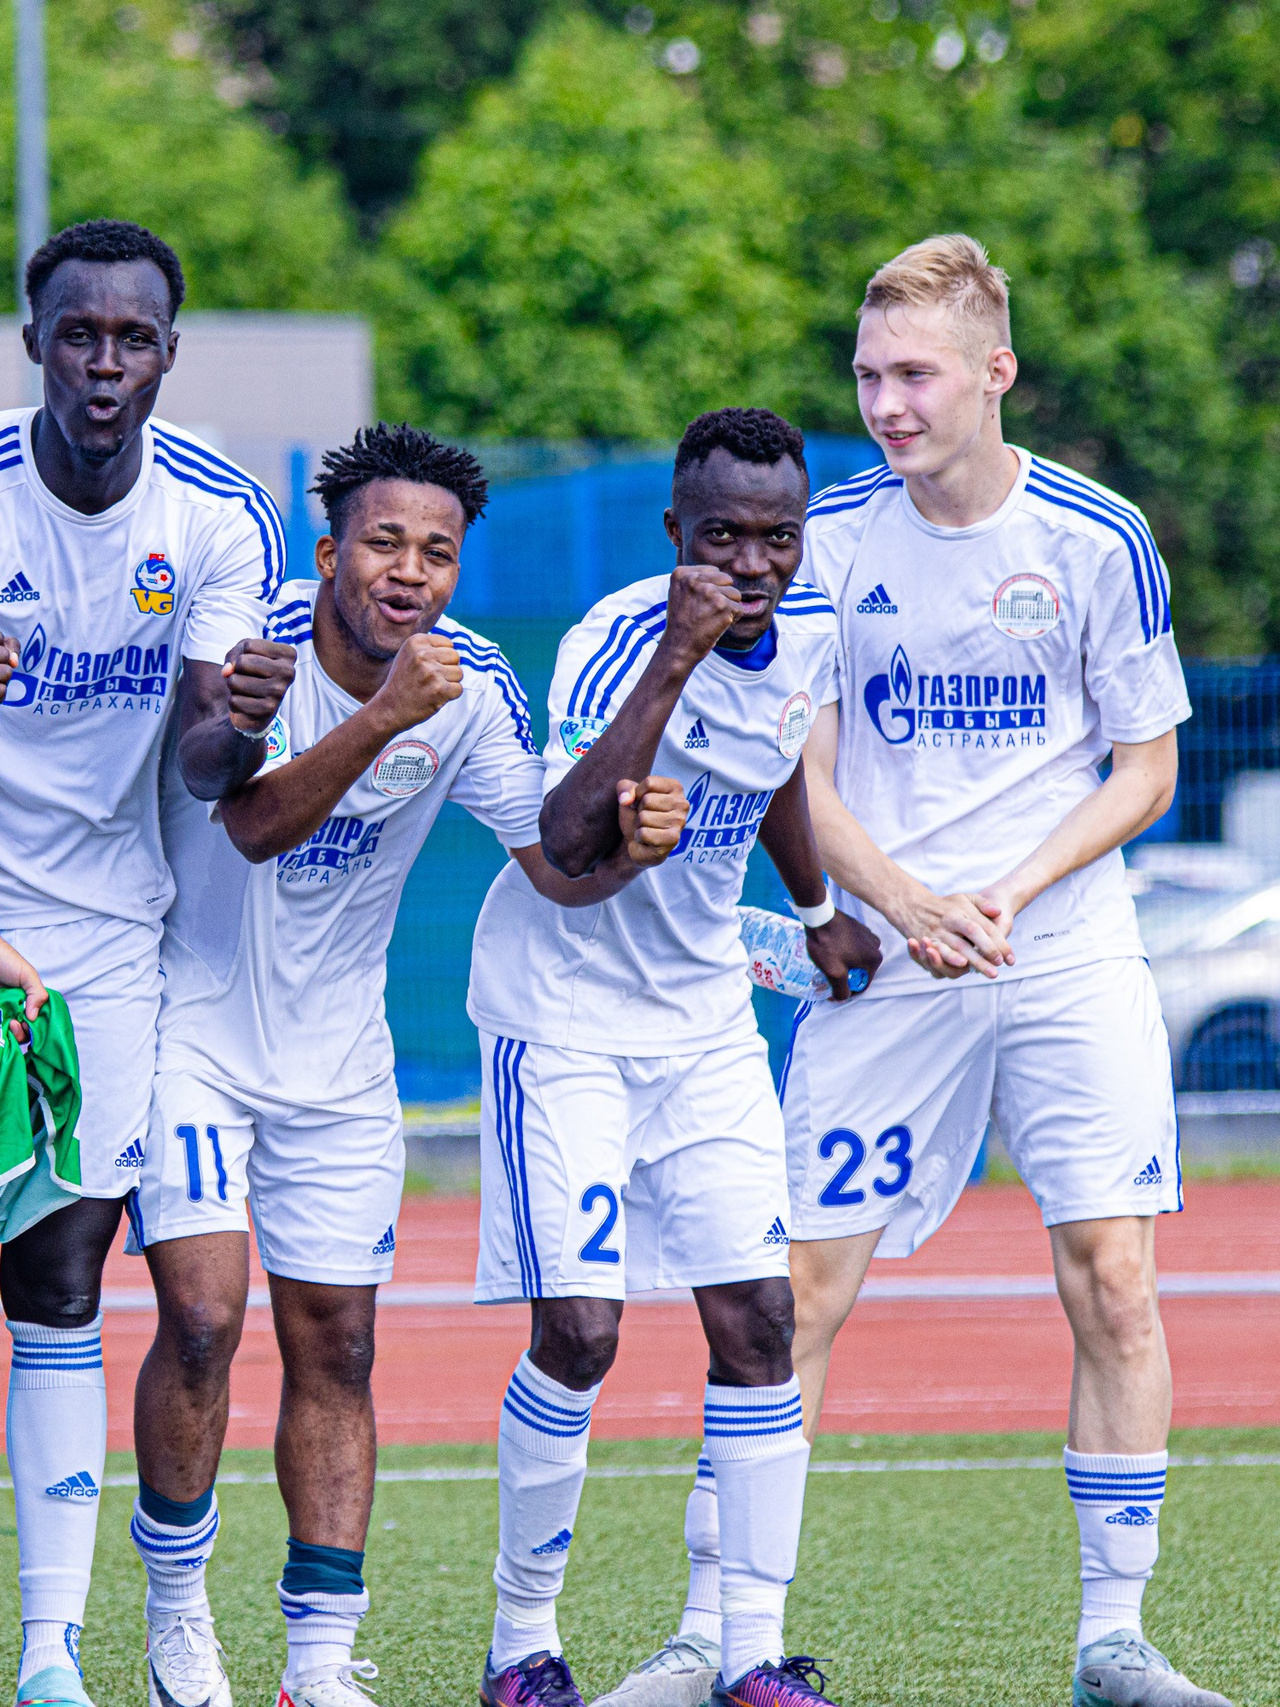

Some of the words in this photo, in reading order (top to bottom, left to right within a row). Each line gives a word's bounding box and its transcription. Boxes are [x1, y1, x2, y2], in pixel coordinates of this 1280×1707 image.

[130, 588, 176, 615] VG
[856, 602, 898, 614] adidas
[44, 643, 168, 684] ГАЗПРОМ
[41, 678, 163, 701] ДОБЫЧА
[917, 674, 1046, 707] ГАЗПРОМ
[33, 696, 161, 715] АСТРАХАНЬ
[920, 711, 1041, 729] ДОБЫЧА
[917, 731, 1046, 748] АСТРАХАНЬ
[175, 1123, 228, 1203] 11
[817, 1124, 915, 1209] 23
[578, 1183, 621, 1265] 2
[46, 1486, 99, 1498] adidas
